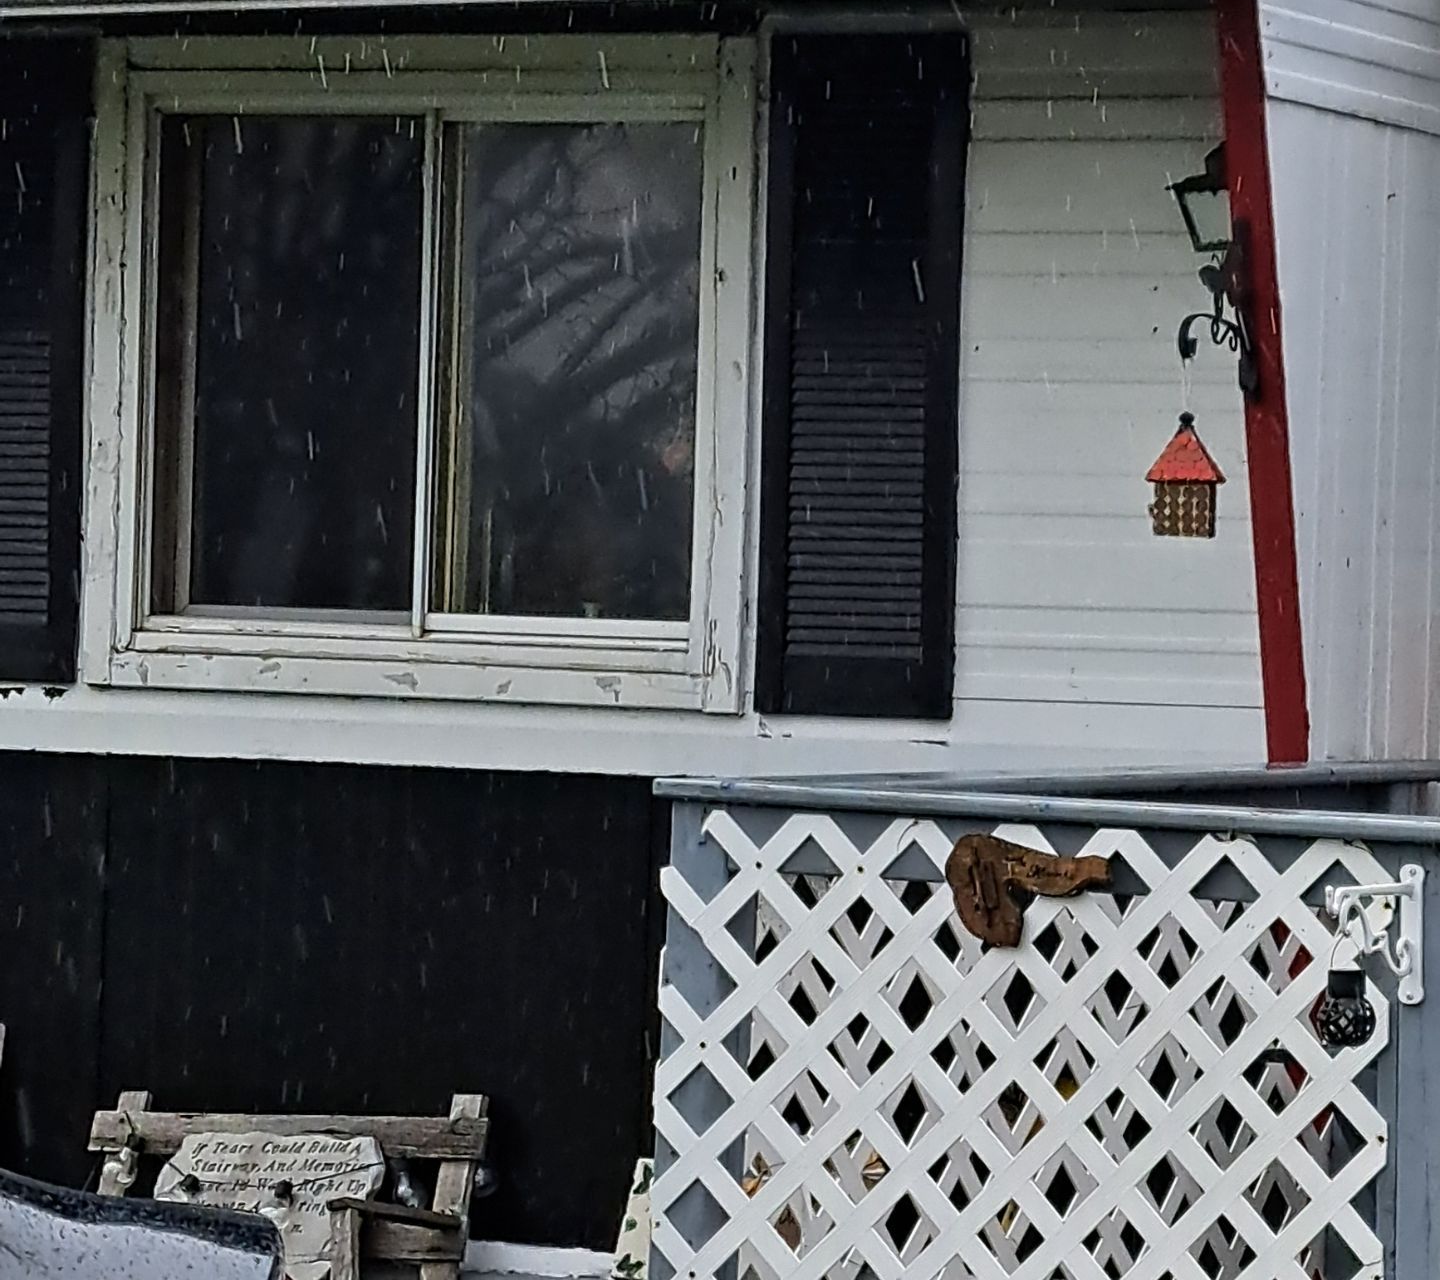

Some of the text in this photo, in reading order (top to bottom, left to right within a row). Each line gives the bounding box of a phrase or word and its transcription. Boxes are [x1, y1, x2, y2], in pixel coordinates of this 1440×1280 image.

[191, 1140, 362, 1159] If Tears Could Build A
[261, 1158, 296, 1173] And
[346, 1178, 367, 1195] Up
